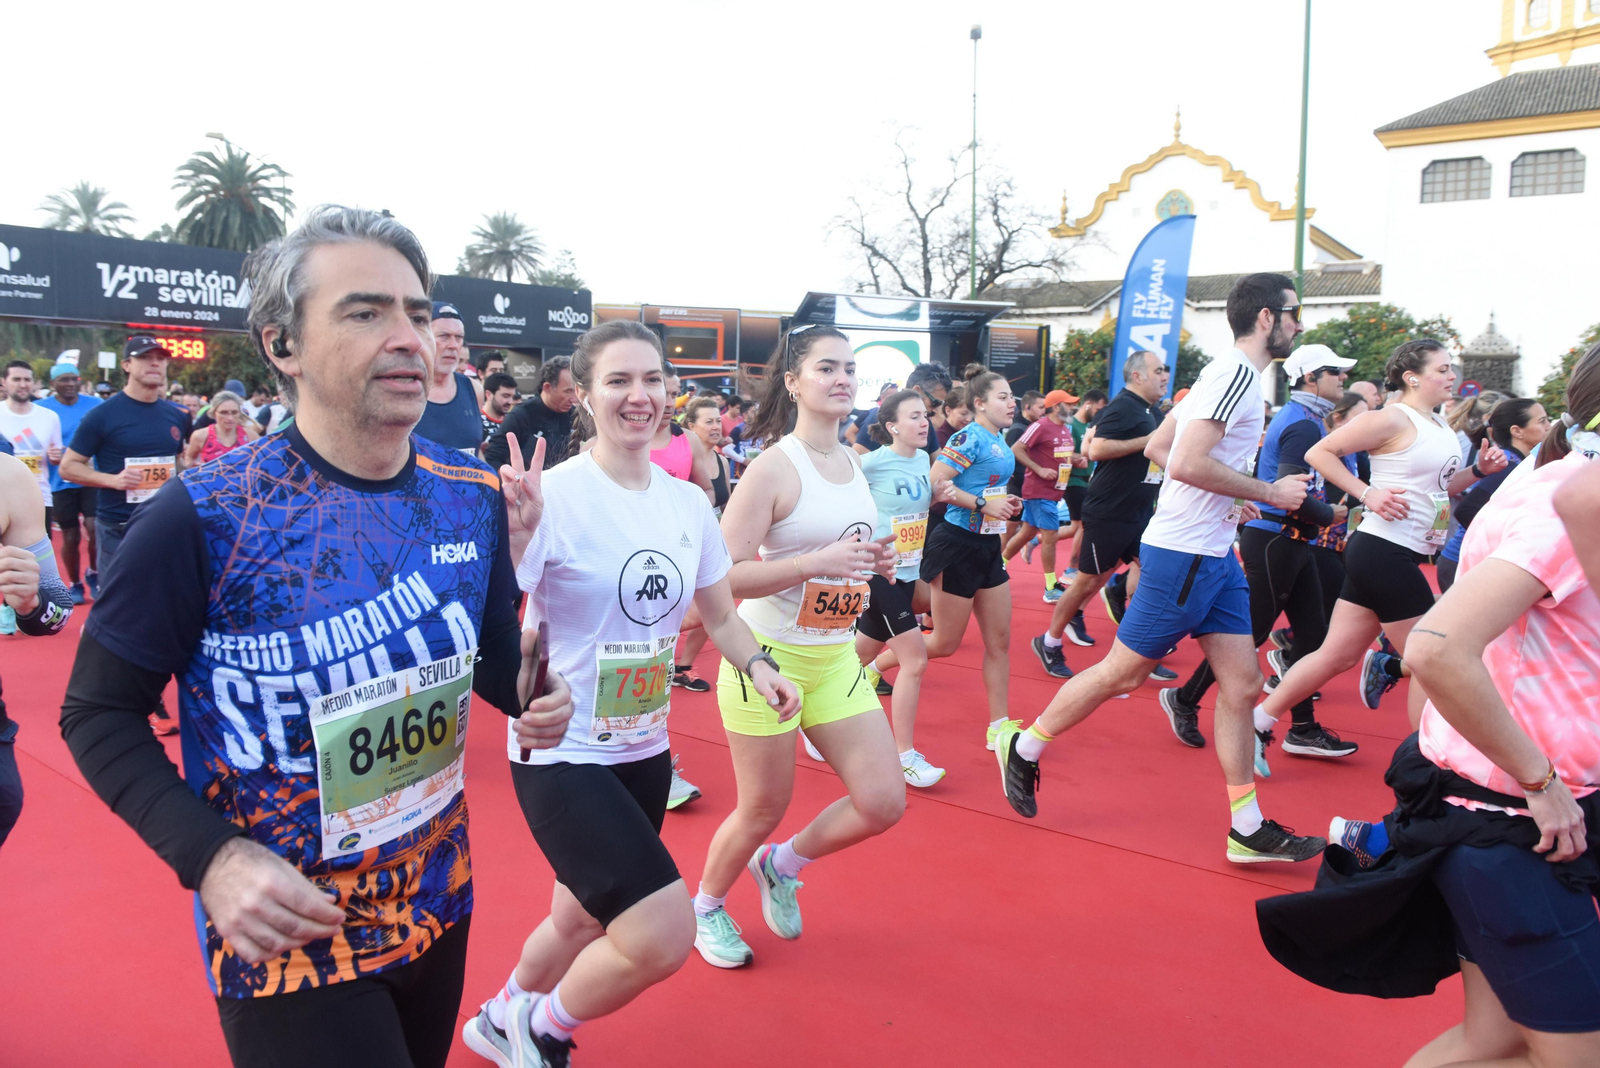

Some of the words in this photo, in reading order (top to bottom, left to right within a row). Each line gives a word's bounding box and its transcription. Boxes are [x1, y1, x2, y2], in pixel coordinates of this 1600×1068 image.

[0, 273, 51, 288] nsalud
[127, 265, 236, 291] maratón
[1145, 259, 1166, 319] HUMAN
[158, 286, 239, 307] sevilla
[1131, 291, 1148, 318] FLY
[1158, 293, 1175, 319] FLY
[144, 307, 159, 317] 28
[160, 309, 192, 319] enero
[193, 310, 220, 321] 2024
[432, 464, 485, 480] 28ENERO24
[900, 524, 924, 543] 9992
[431, 541, 478, 565] HOKA
[635, 574, 668, 602] AR
[814, 591, 861, 616] 5432
[201, 629, 293, 672] MEDIO
[300, 571, 438, 666] MARATÓN
[604, 644, 622, 654] MEDIO
[624, 642, 650, 653] MARATÓN
[321, 692, 352, 715] MEDIO
[354, 676, 397, 703] MARATÓN
[419, 656, 460, 687] SEVILLA
[616, 662, 666, 699] 7570
[349, 700, 448, 776] 8466
[323, 757, 332, 781] CAJÓN
[388, 759, 418, 775] Juanillo
[401, 808, 422, 824] HOKA
